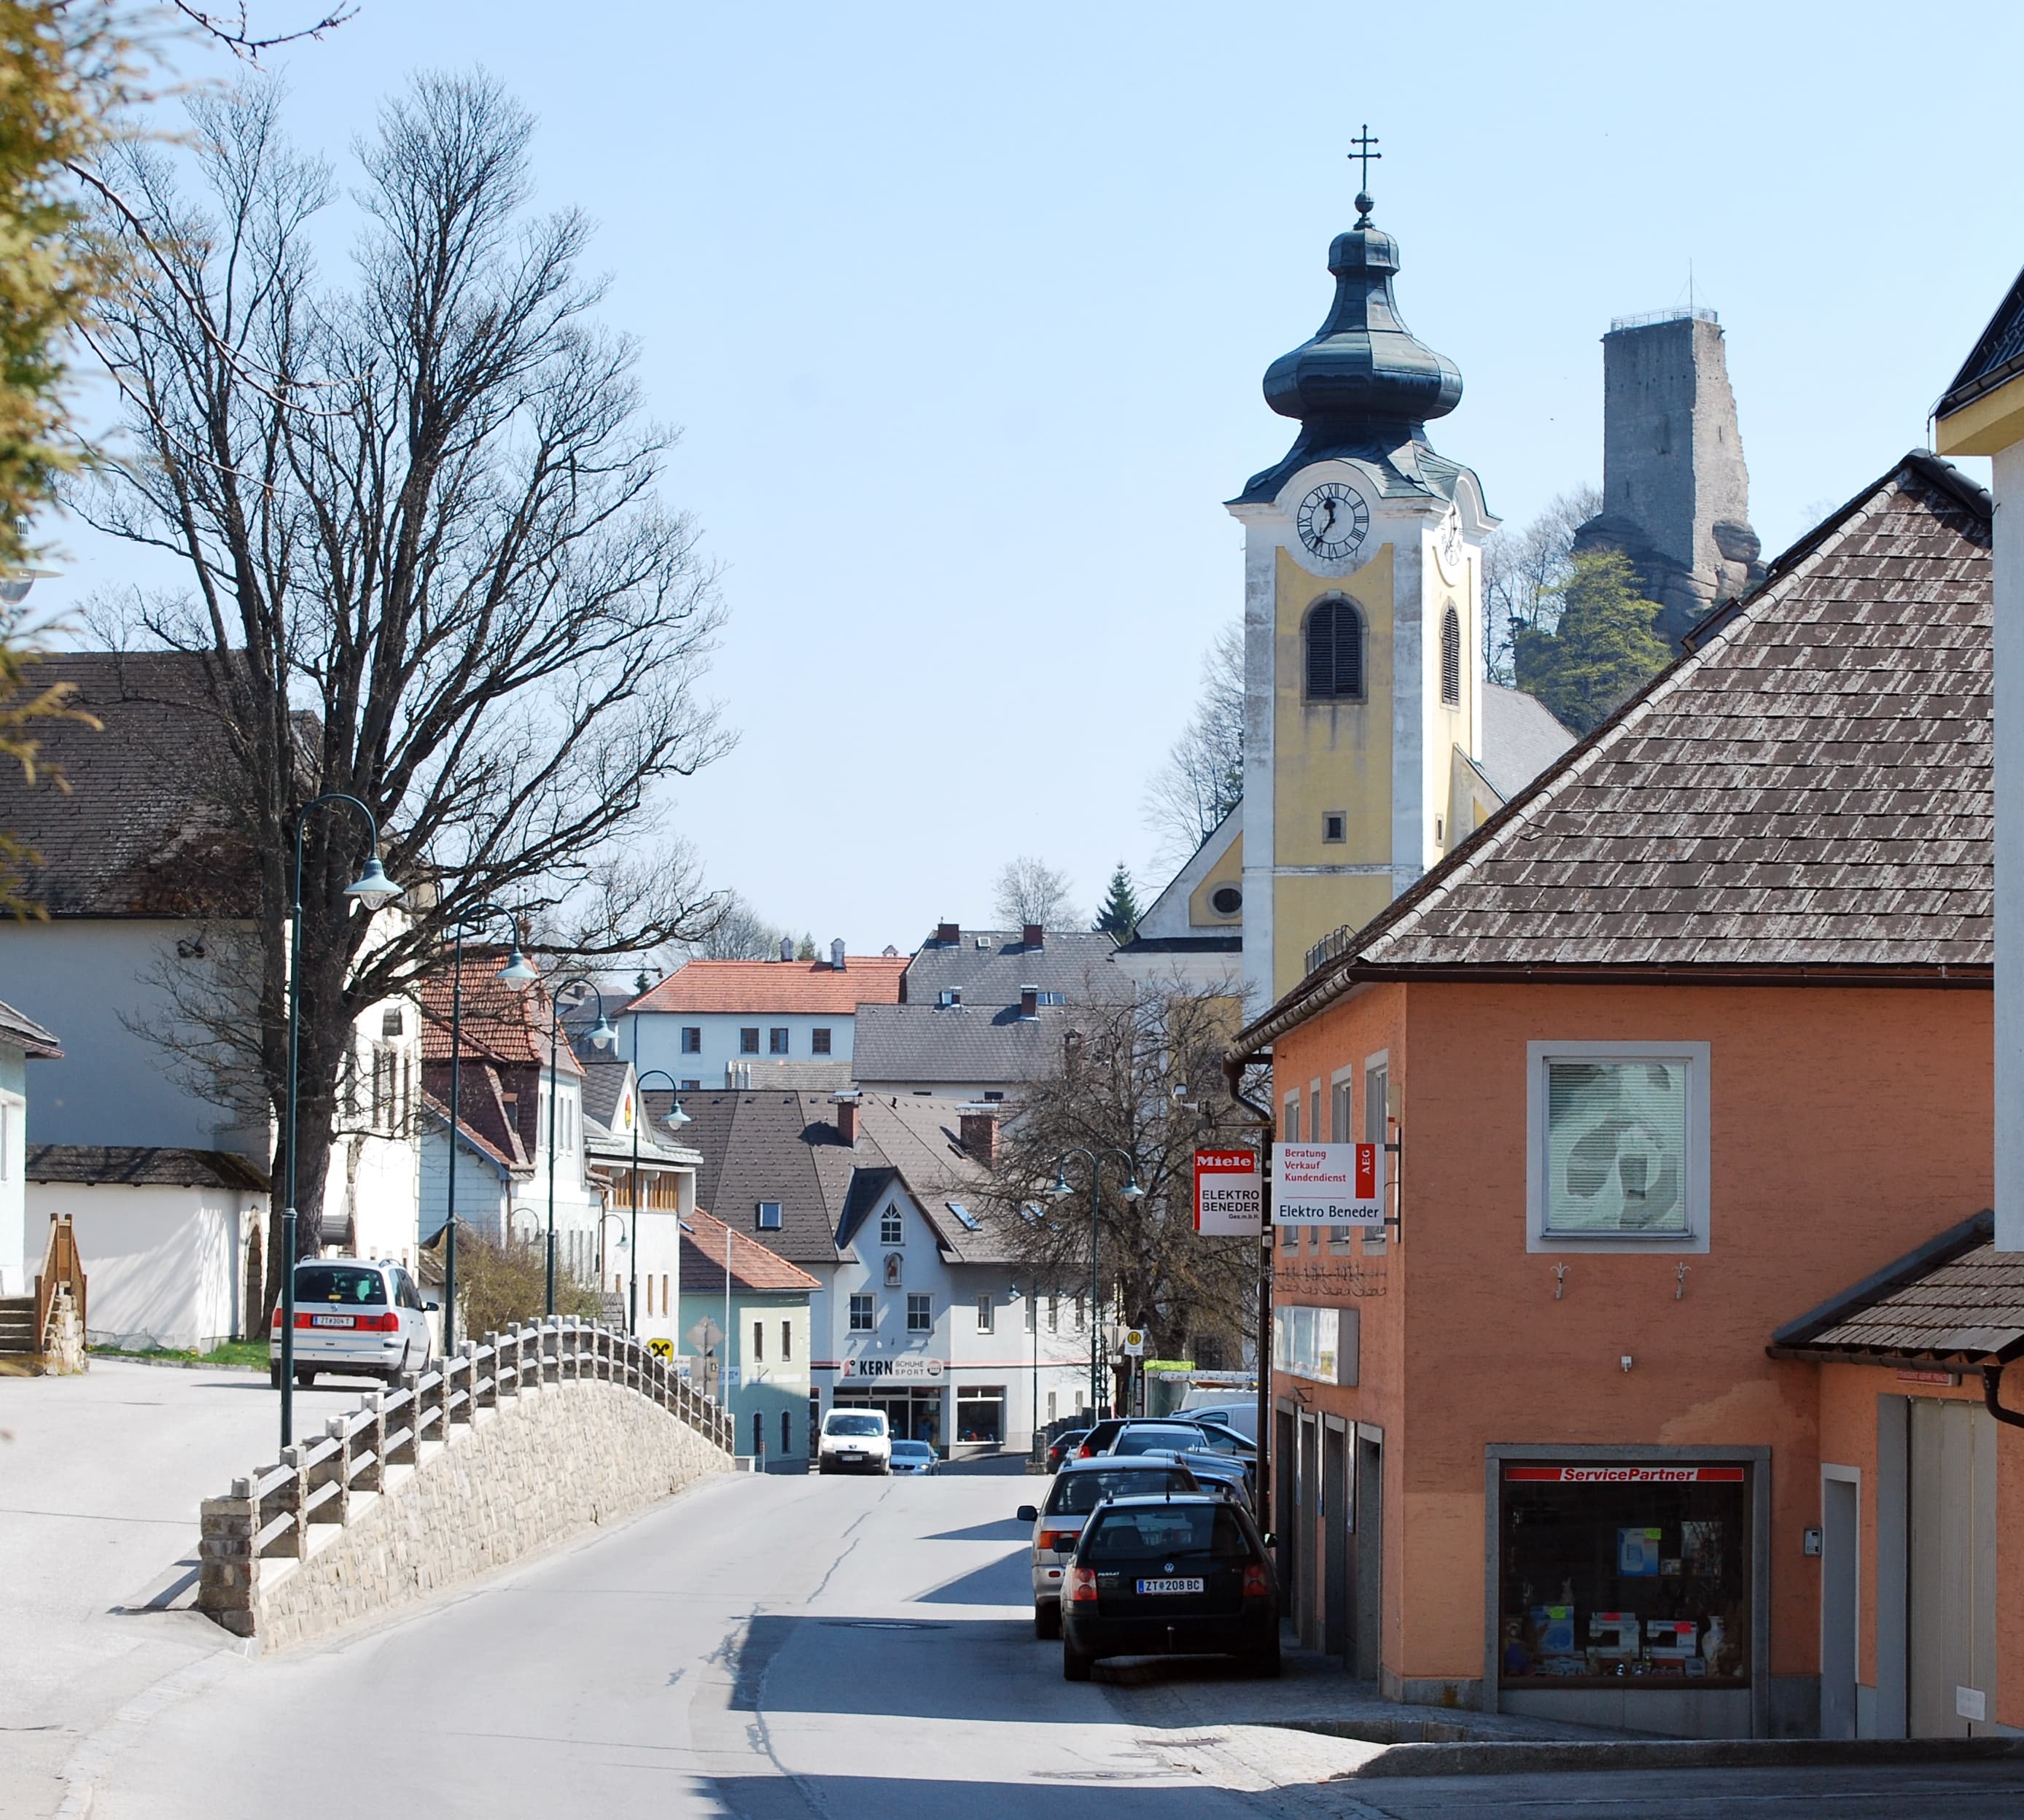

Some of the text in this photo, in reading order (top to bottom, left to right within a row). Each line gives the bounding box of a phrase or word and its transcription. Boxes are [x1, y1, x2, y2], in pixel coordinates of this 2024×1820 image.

[1285, 1148, 1326, 1159] Beratung
[1196, 1156, 1251, 1166] Miele
[1285, 1161, 1321, 1170] Verkauf
[1361, 1149, 1371, 1175] AEG
[1285, 1172, 1347, 1182] Kundendienst
[1202, 1190, 1260, 1199] ELEKTRO
[1202, 1202, 1260, 1212] BENEDER
[1280, 1205, 1379, 1218] Elektro Beneder
[860, 1361, 893, 1375] KERN
[1564, 1469, 1694, 1480] ServicePartner
[1145, 1580, 1199, 1591] ZT 208 BC
